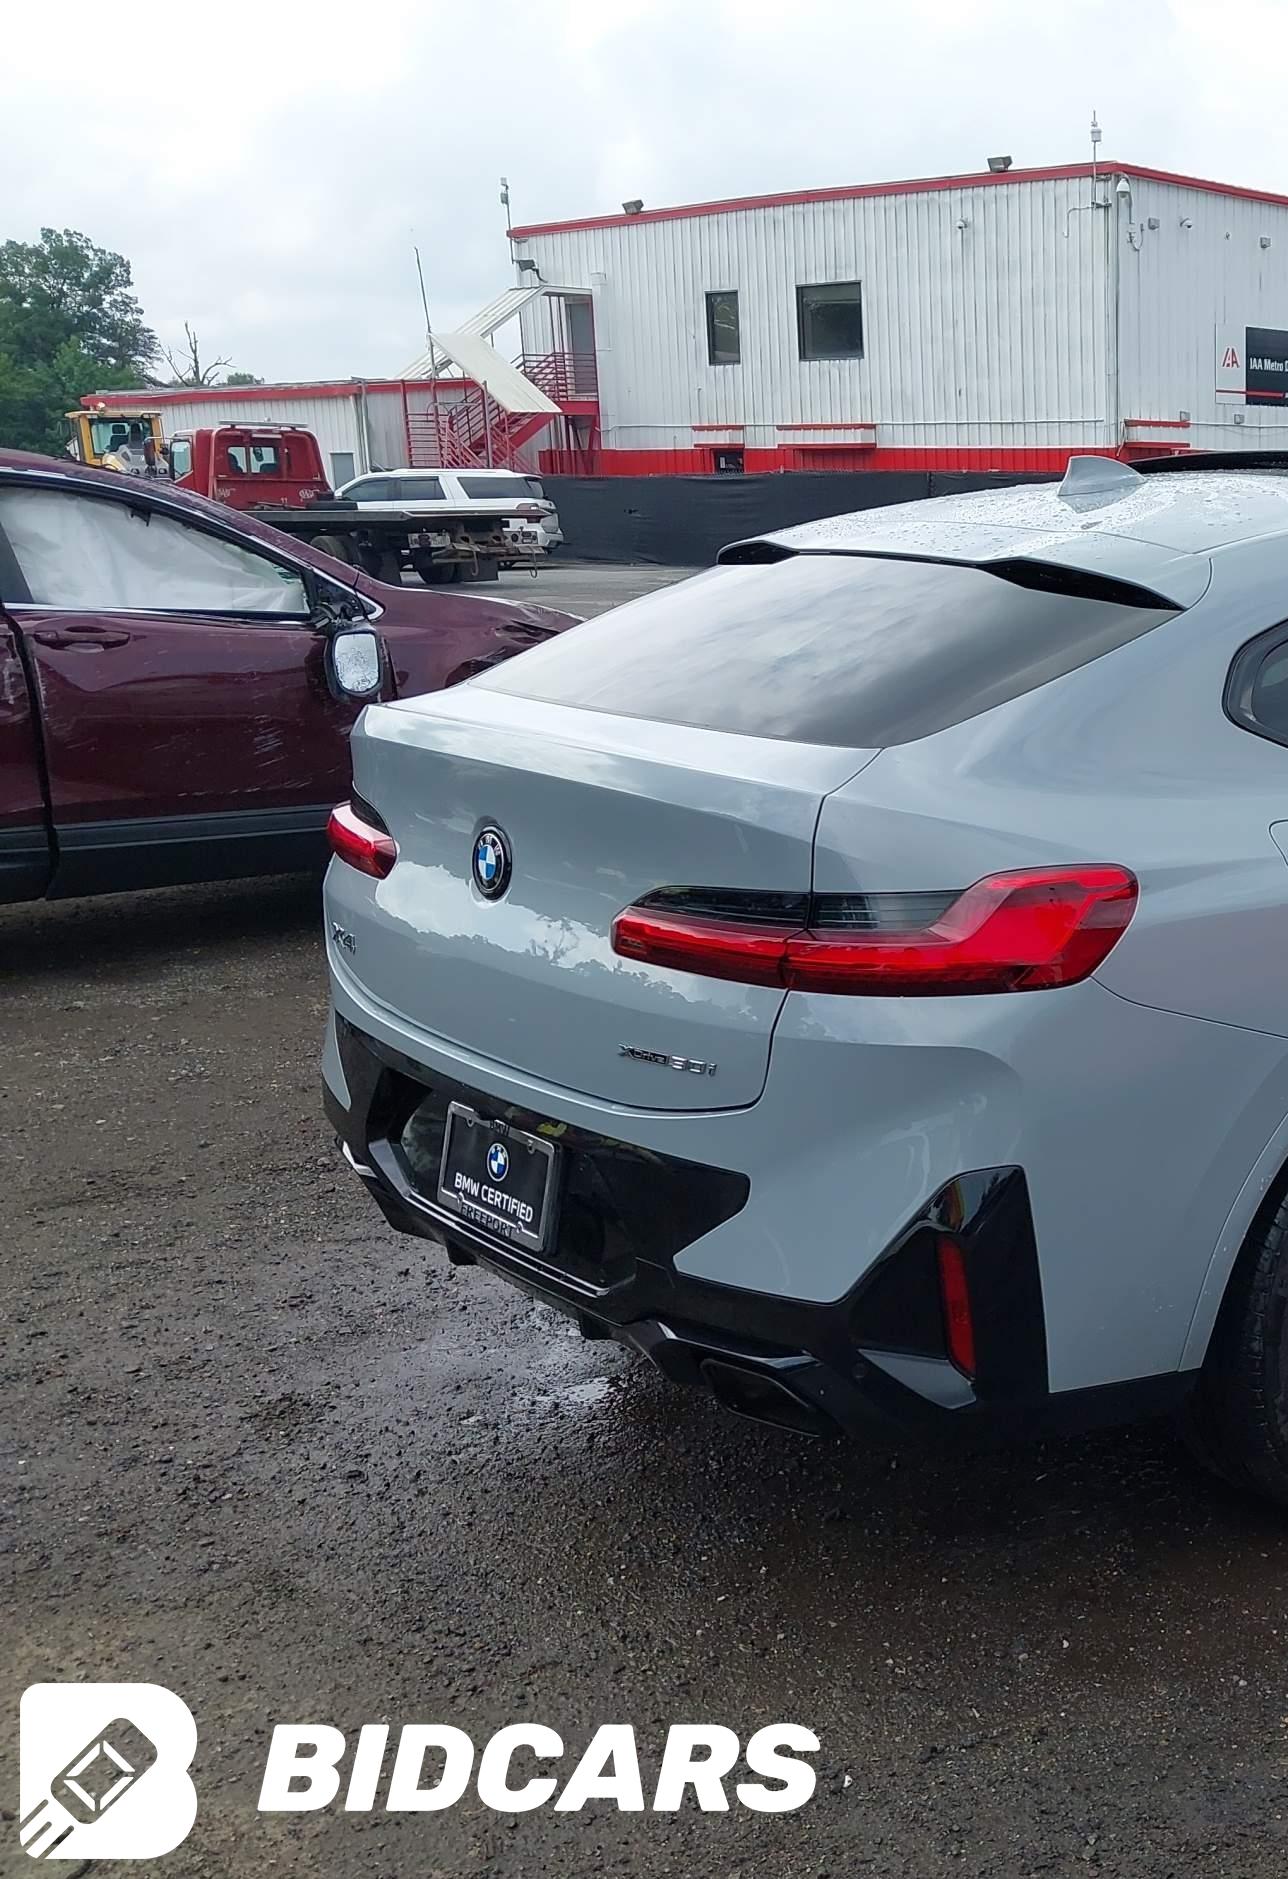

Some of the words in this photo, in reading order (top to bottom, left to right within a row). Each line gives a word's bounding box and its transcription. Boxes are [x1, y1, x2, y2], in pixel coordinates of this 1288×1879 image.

[1249, 357, 1263, 370] IAA
[1263, 358, 1283, 372] Metro
[454, 1171, 480, 1198] BMW
[480, 1184, 534, 1223] CERTIFIED
[460, 1203, 515, 1239] FREEPORT
